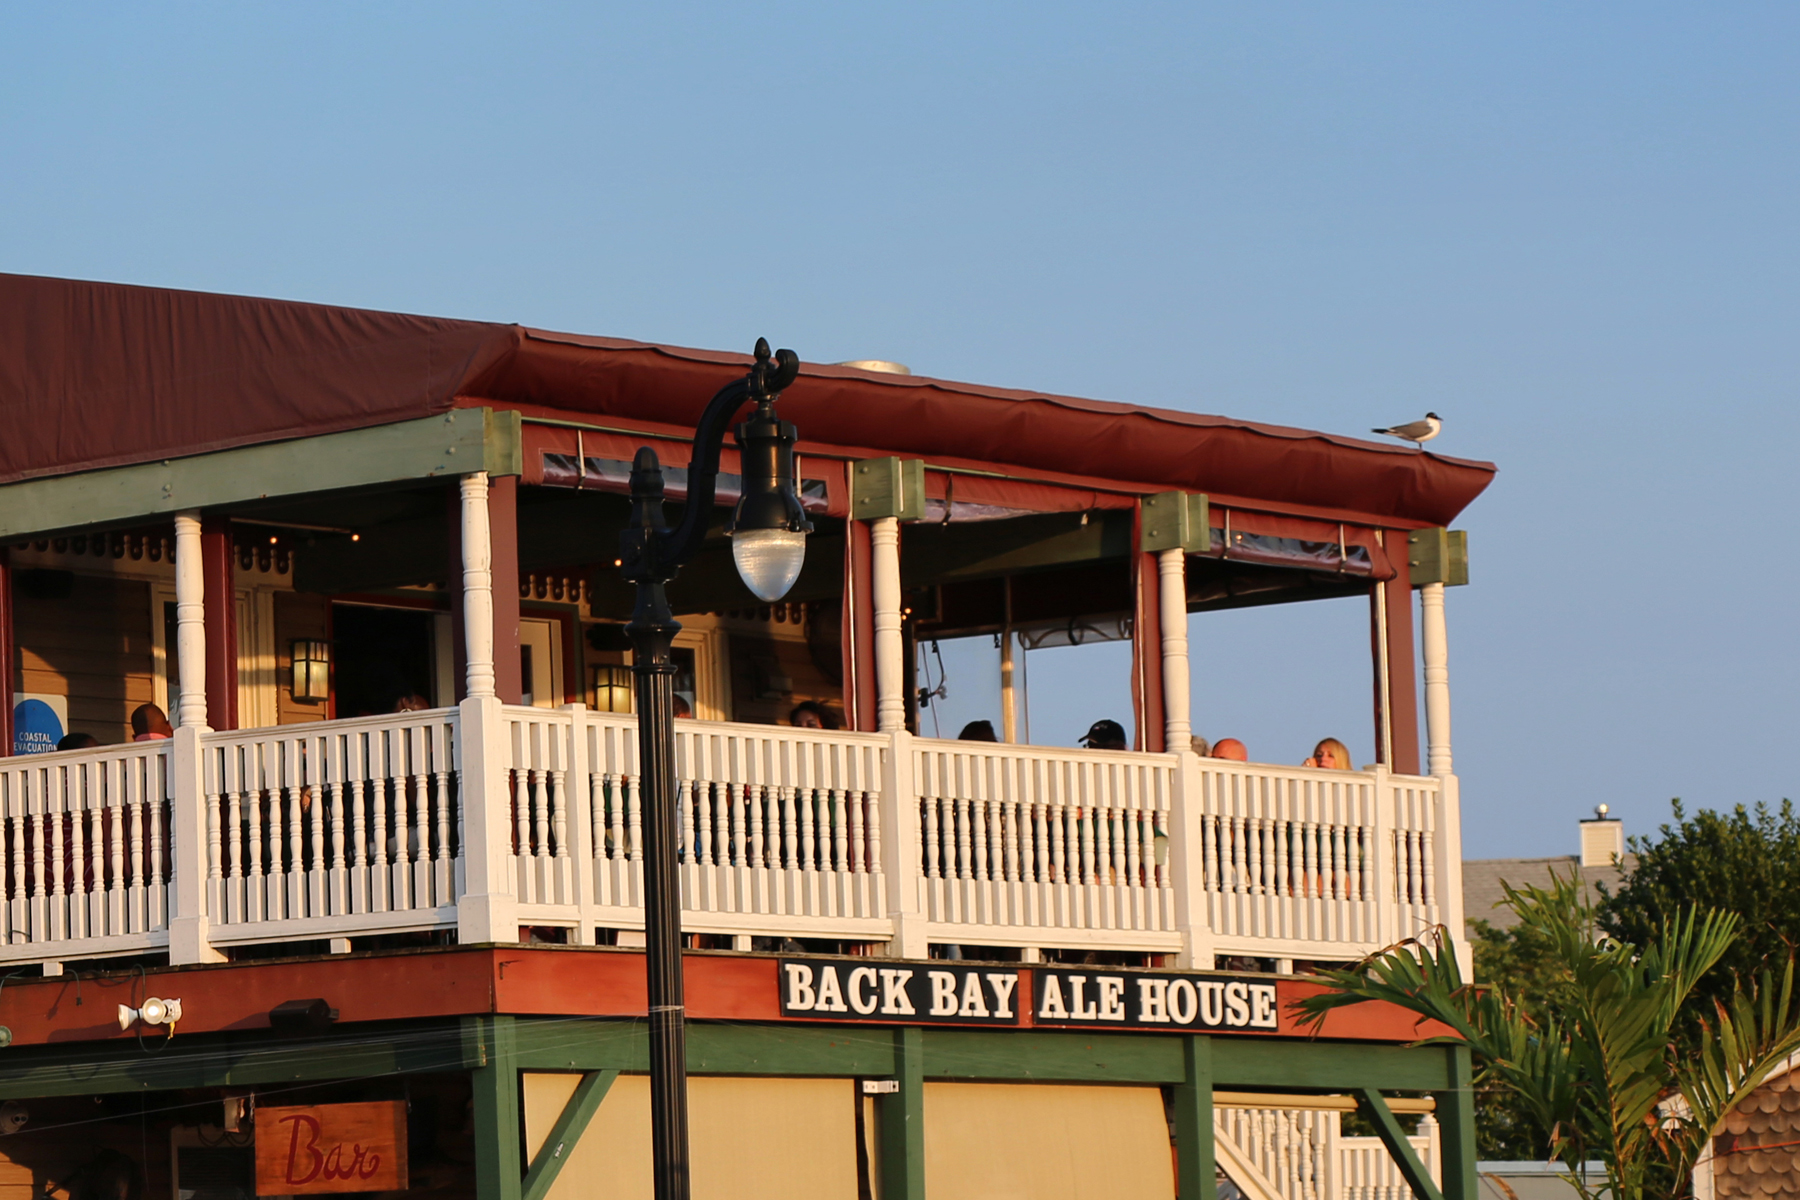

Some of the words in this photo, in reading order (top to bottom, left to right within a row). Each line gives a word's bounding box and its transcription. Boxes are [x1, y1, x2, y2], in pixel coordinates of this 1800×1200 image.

[18, 731, 52, 743] COASTAL
[784, 962, 916, 1016] BACK
[928, 971, 1019, 1019] BAY
[1038, 973, 1126, 1021] ALE
[1136, 977, 1278, 1029] HOUSE
[278, 1114, 381, 1186] Bar
